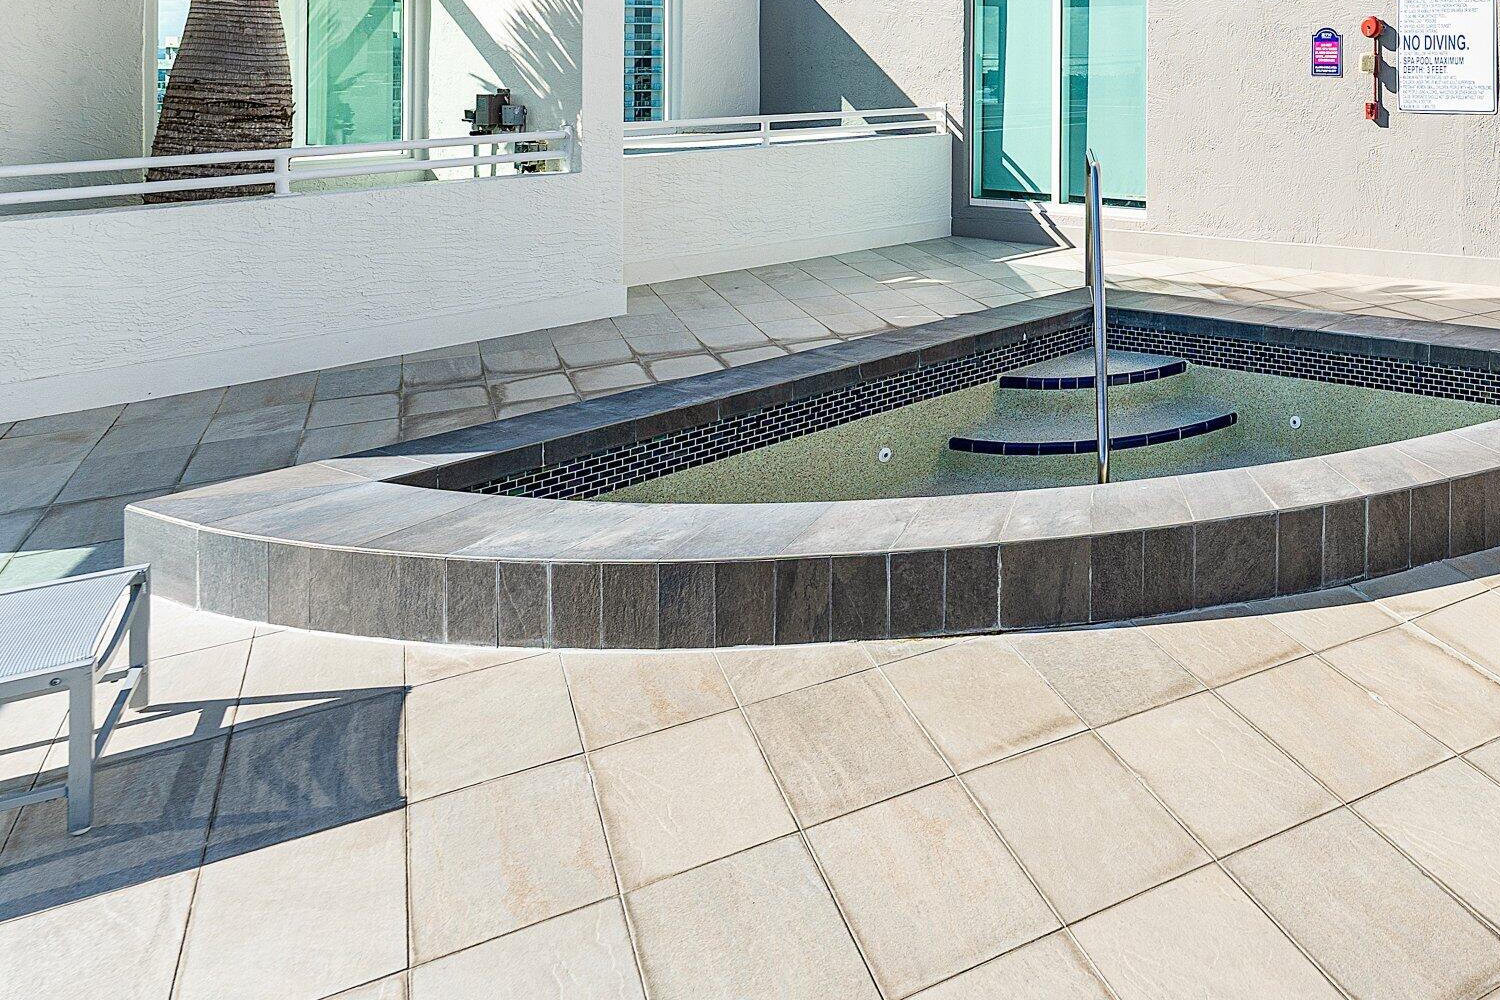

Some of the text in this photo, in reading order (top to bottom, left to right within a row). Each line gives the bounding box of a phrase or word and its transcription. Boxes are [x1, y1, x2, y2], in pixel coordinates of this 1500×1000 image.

[1403, 35, 1470, 51] NO DIVING.
[1403, 56, 1465, 65] SPA POOL MAXIMUM
[1427, 65, 1431, 74] 3
